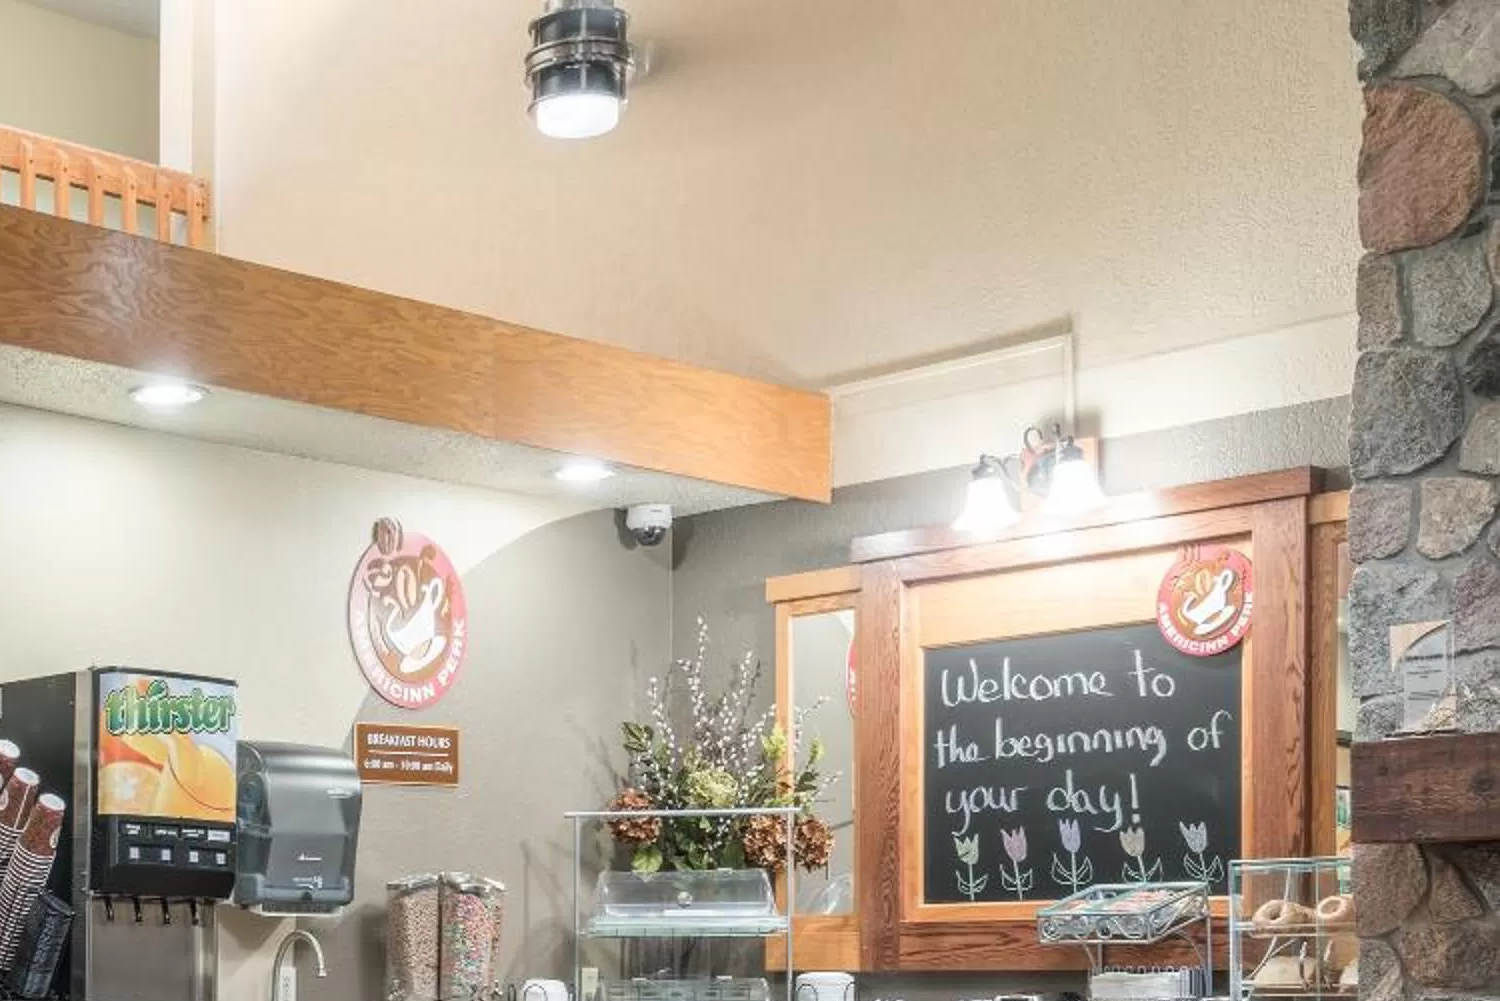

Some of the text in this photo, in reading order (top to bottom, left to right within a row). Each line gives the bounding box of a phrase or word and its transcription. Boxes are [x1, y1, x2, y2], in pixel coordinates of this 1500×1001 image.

[436, 617, 466, 688] PERK
[941, 649, 1176, 707] Welcome to
[104, 679, 237, 736] thirster
[367, 732, 452, 750] BREAKFAST HOURS
[932, 709, 1234, 769] the beginning of
[944, 769, 1141, 837] your day!
